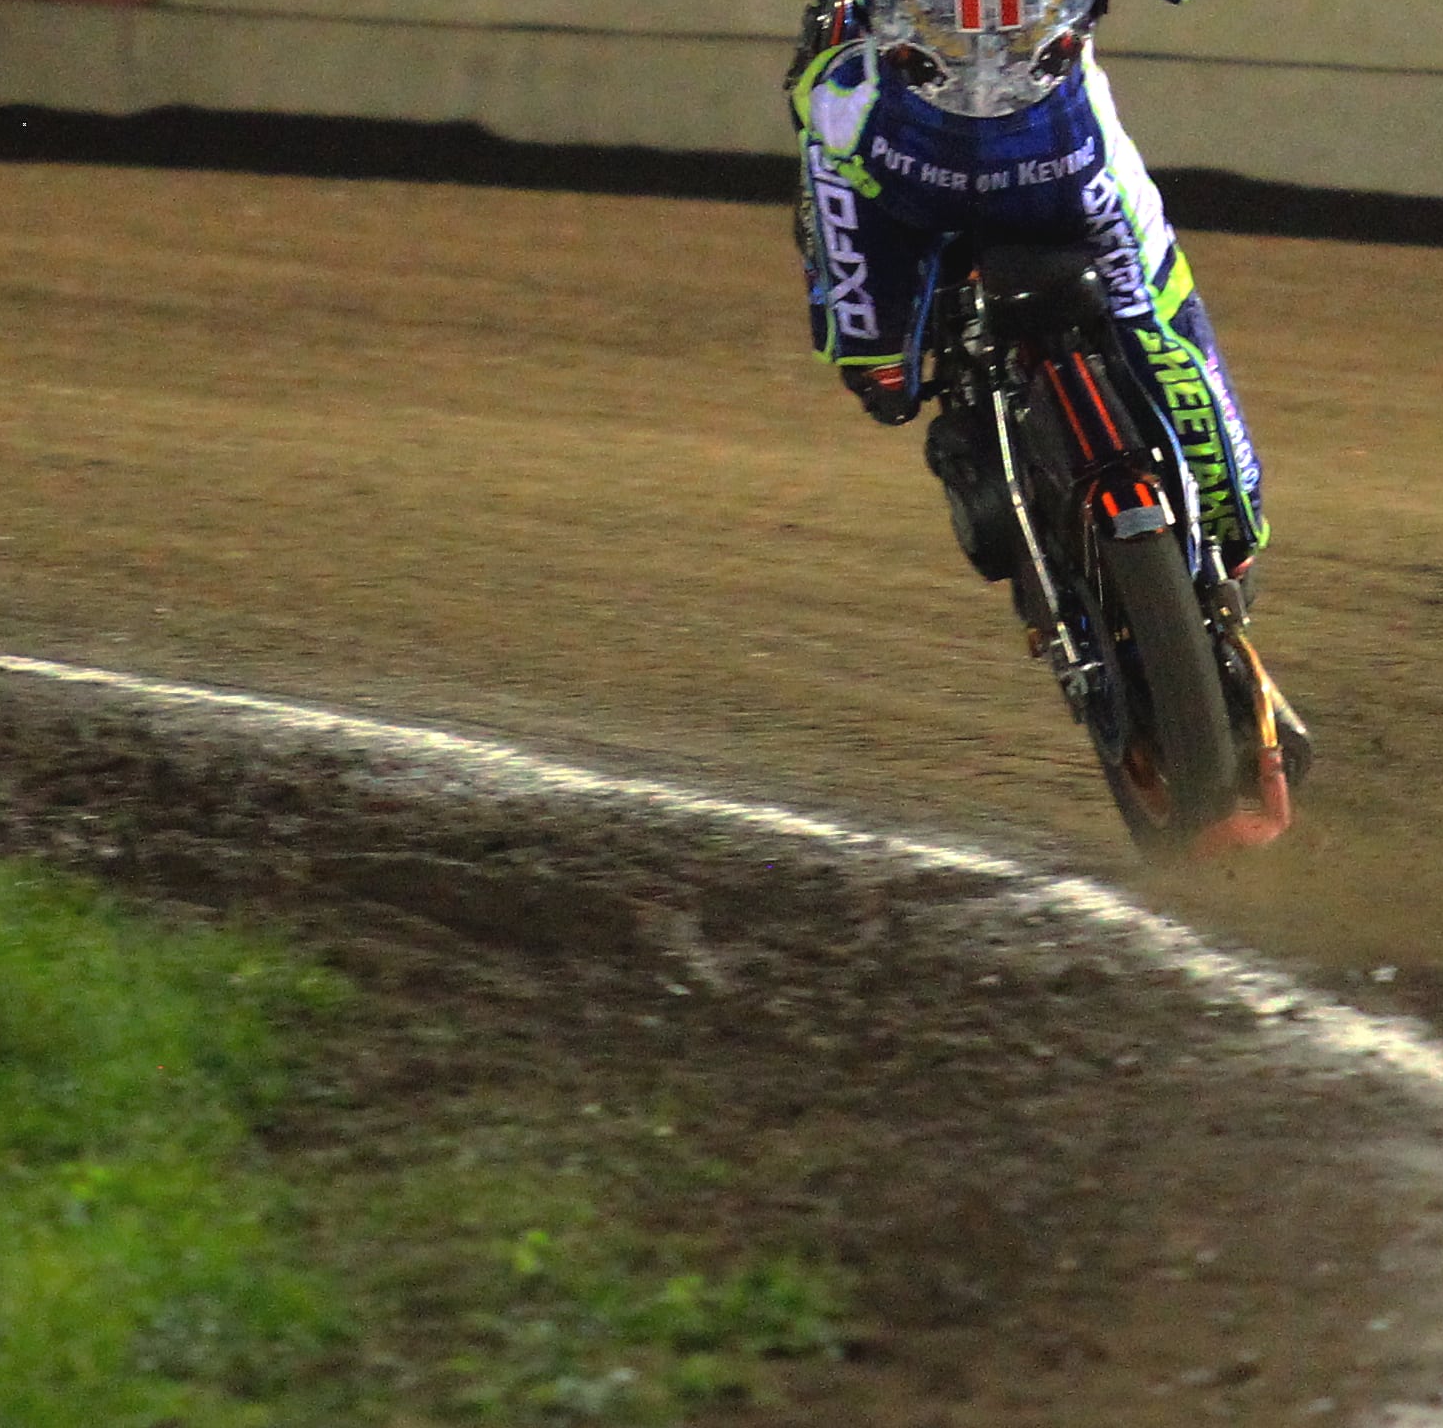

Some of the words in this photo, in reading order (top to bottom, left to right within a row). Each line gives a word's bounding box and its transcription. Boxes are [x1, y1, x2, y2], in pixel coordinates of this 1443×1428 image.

[871, 135, 916, 176] PUT
[920, 163, 968, 191] HER
[975, 171, 1011, 193] ON
